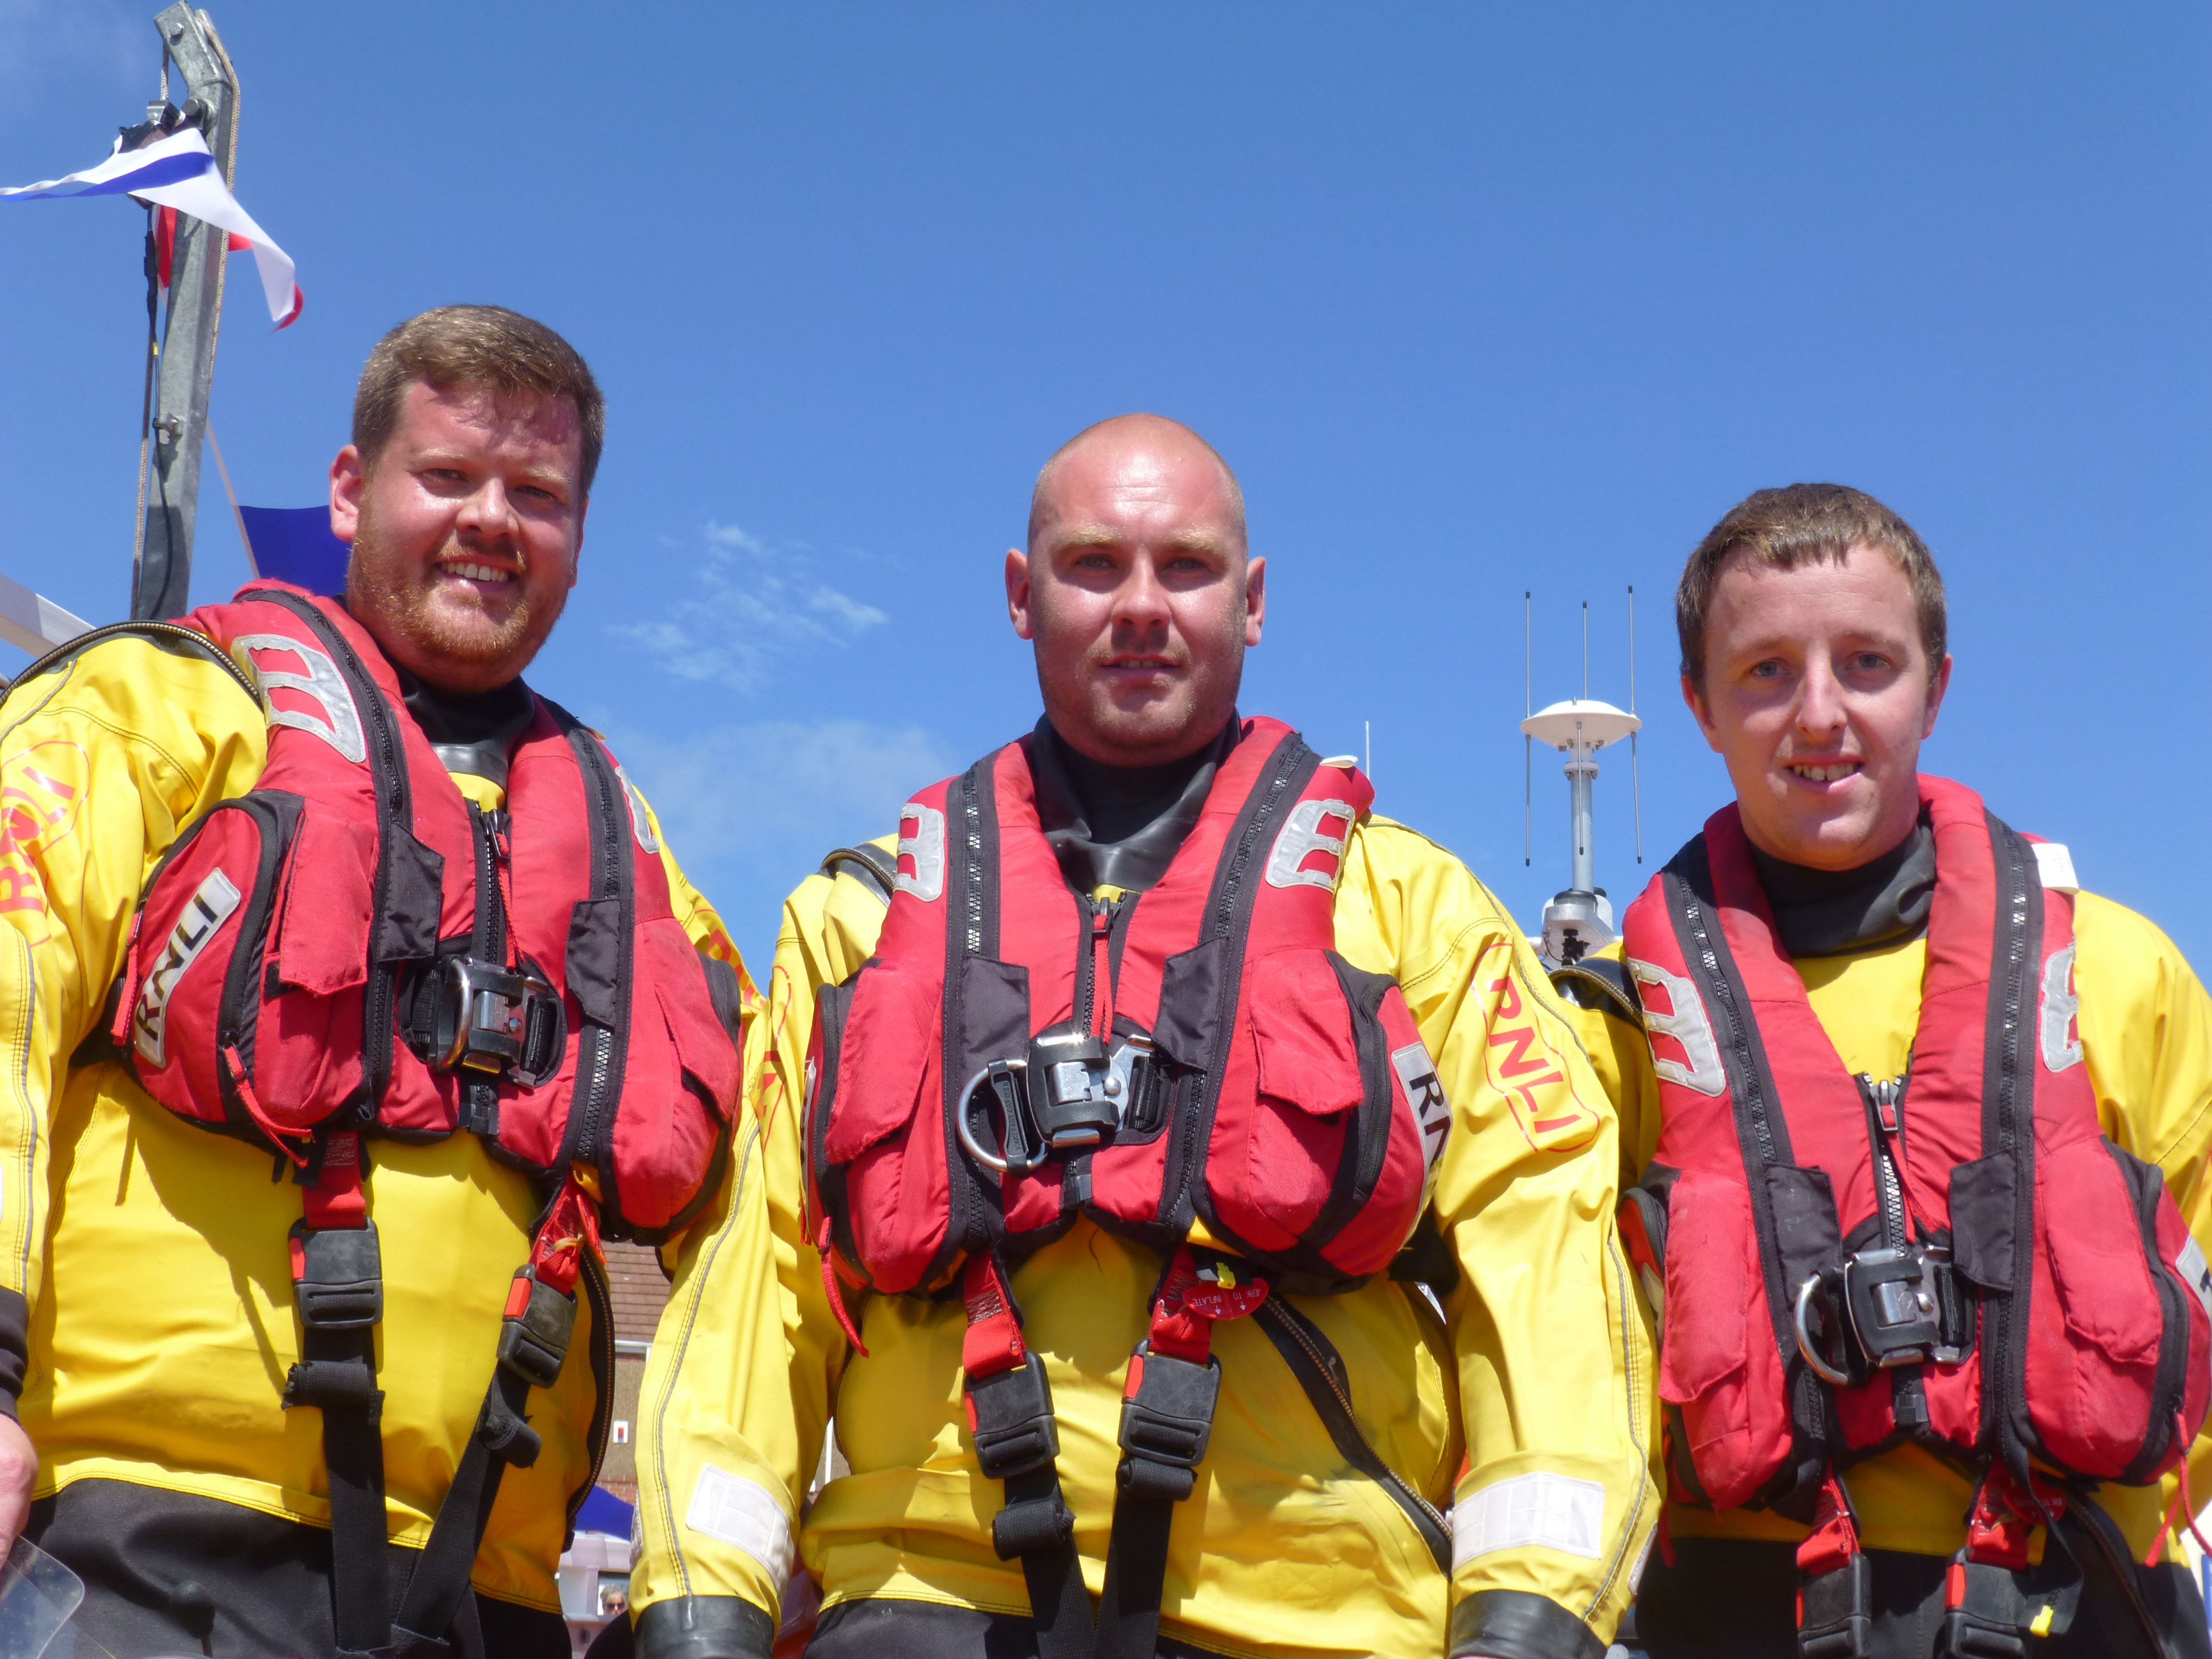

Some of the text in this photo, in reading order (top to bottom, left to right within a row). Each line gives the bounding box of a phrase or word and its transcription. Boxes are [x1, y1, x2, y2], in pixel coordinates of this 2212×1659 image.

[136, 893, 218, 1041] RNLI
[1194, 1289, 1261, 1306] JERK TO INFLATE
